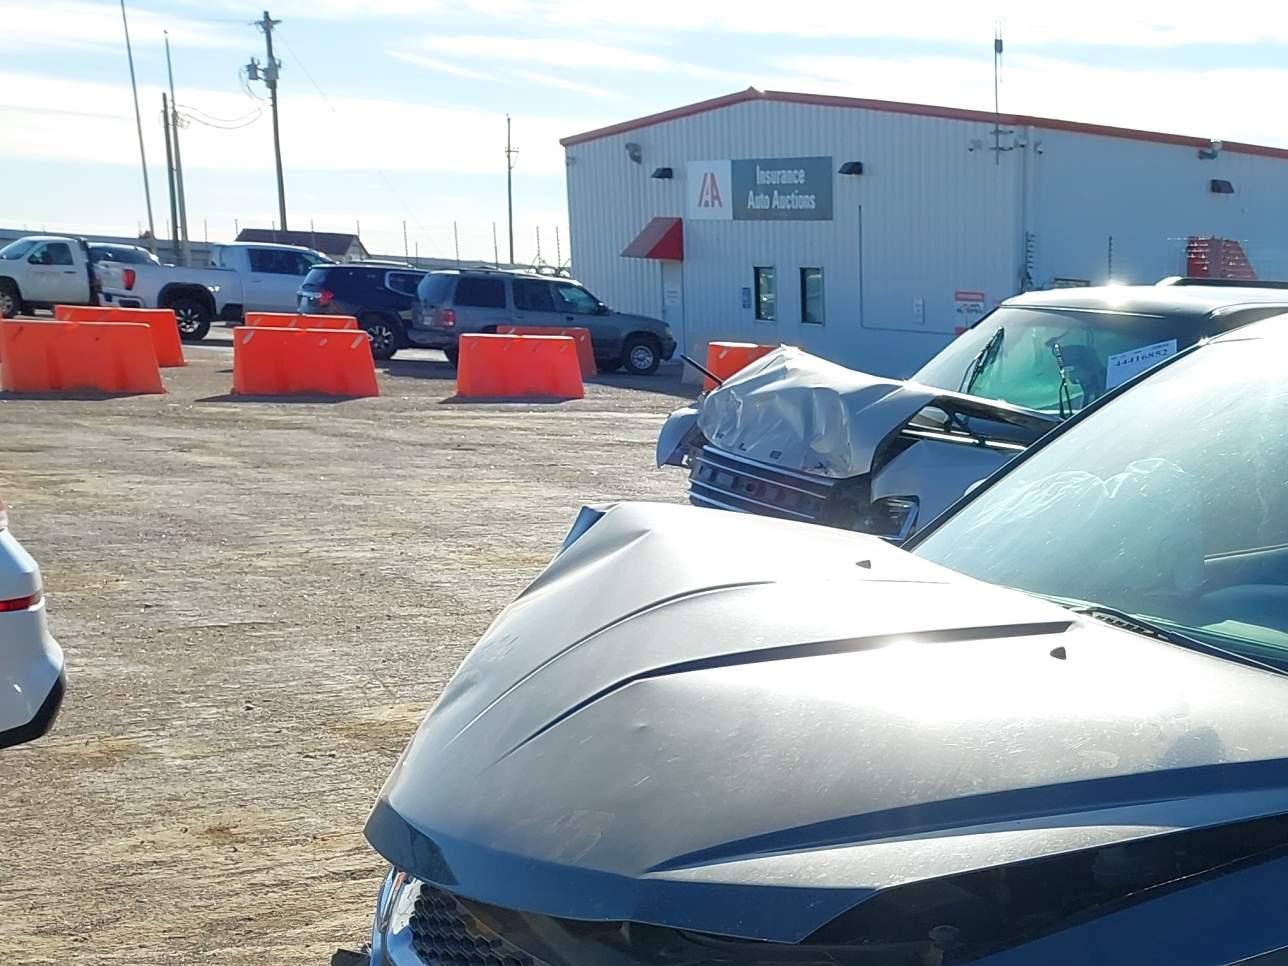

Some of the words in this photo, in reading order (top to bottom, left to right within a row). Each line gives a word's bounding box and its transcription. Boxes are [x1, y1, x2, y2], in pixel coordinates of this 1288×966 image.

[756, 165, 805, 185] Insurance
[747, 190, 770, 209] Auto
[772, 189, 816, 209] Auctions
